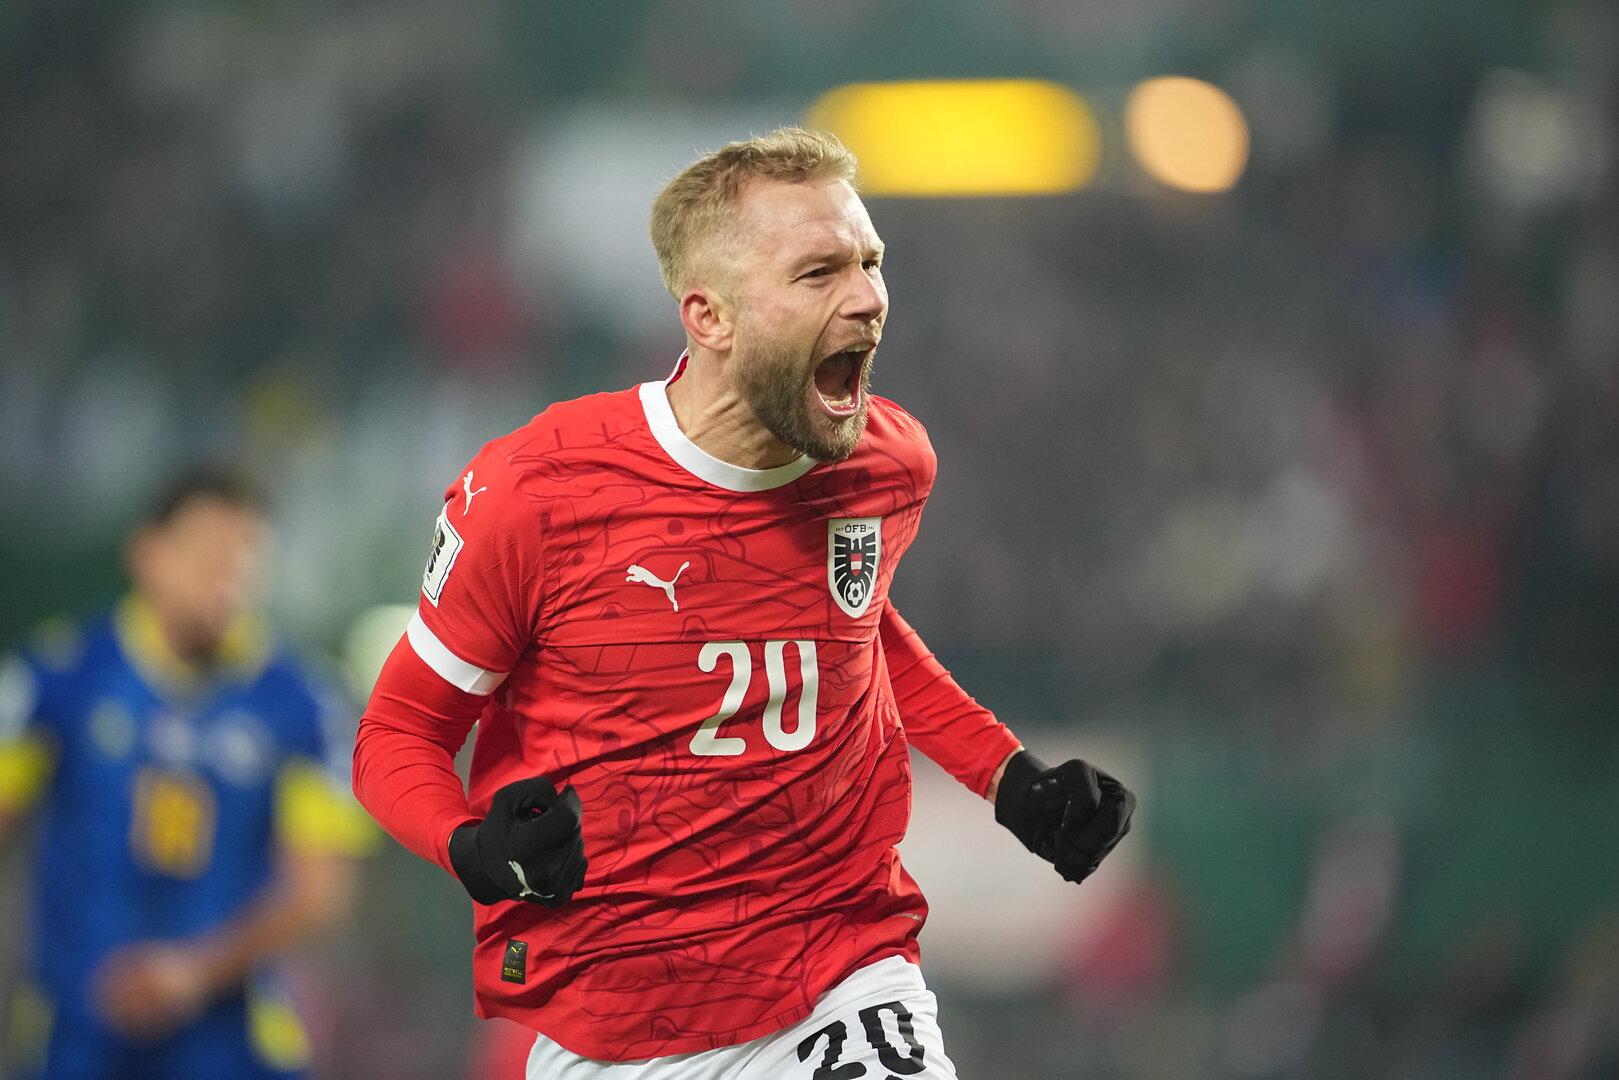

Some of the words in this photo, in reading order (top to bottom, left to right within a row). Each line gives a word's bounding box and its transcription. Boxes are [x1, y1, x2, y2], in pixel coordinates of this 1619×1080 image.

[844, 523, 867, 533] ÖFB
[689, 640, 819, 756] 20
[797, 1001, 927, 1080] 20
